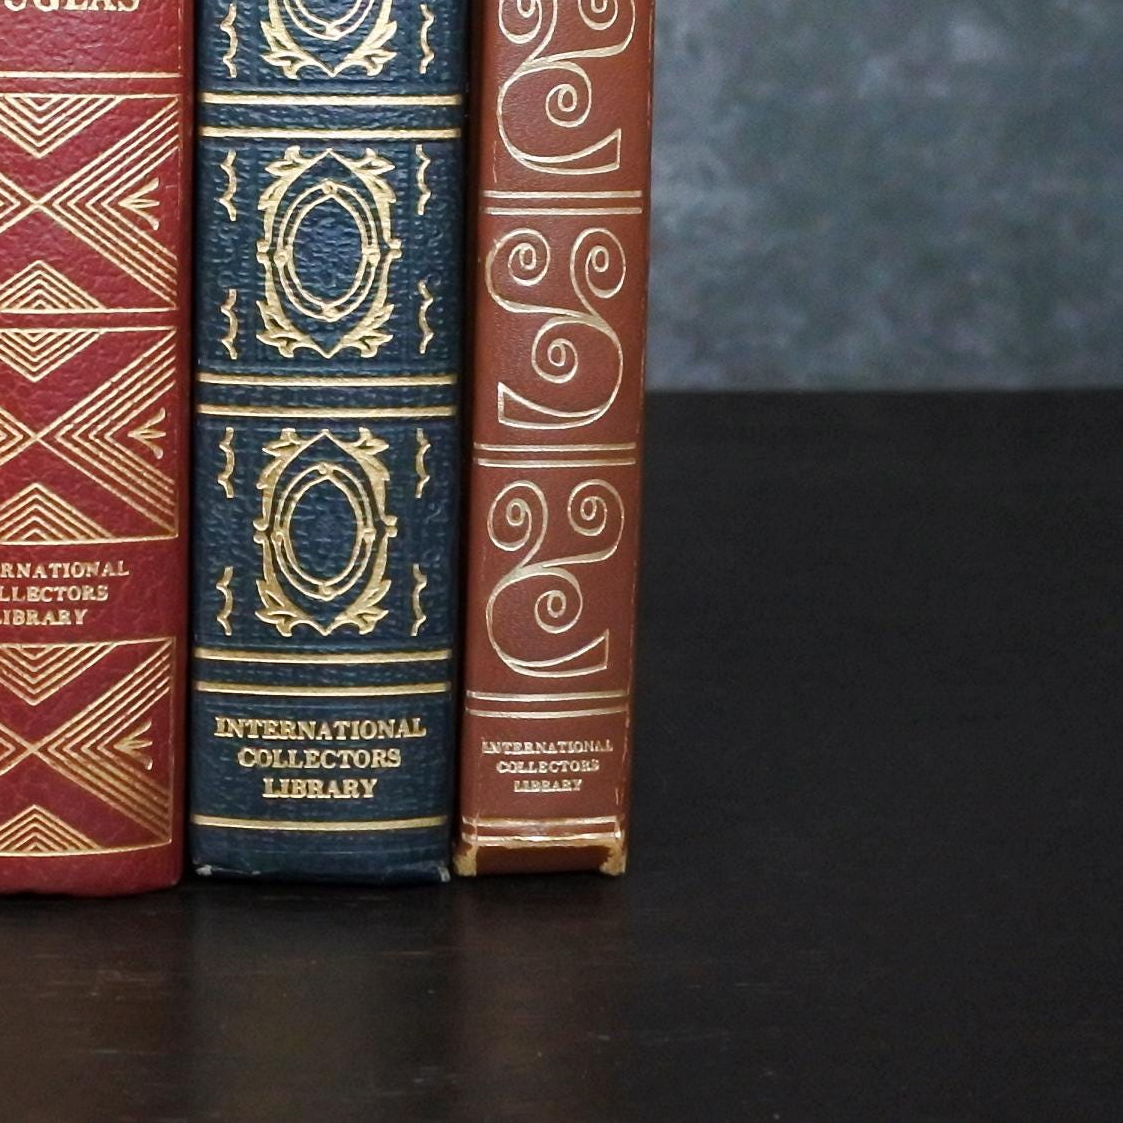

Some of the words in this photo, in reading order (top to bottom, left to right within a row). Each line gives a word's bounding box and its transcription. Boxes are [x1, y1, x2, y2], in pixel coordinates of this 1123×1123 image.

[214, 716, 427, 741] INTERNATIONAL
[481, 738, 613, 755] INTERNATIONAL
[238, 748, 401, 770] COLLECTORS
[495, 760, 600, 774] COLLECTORS
[262, 778, 378, 799] LIBRARY
[513, 779, 583, 794] LIBRARY
